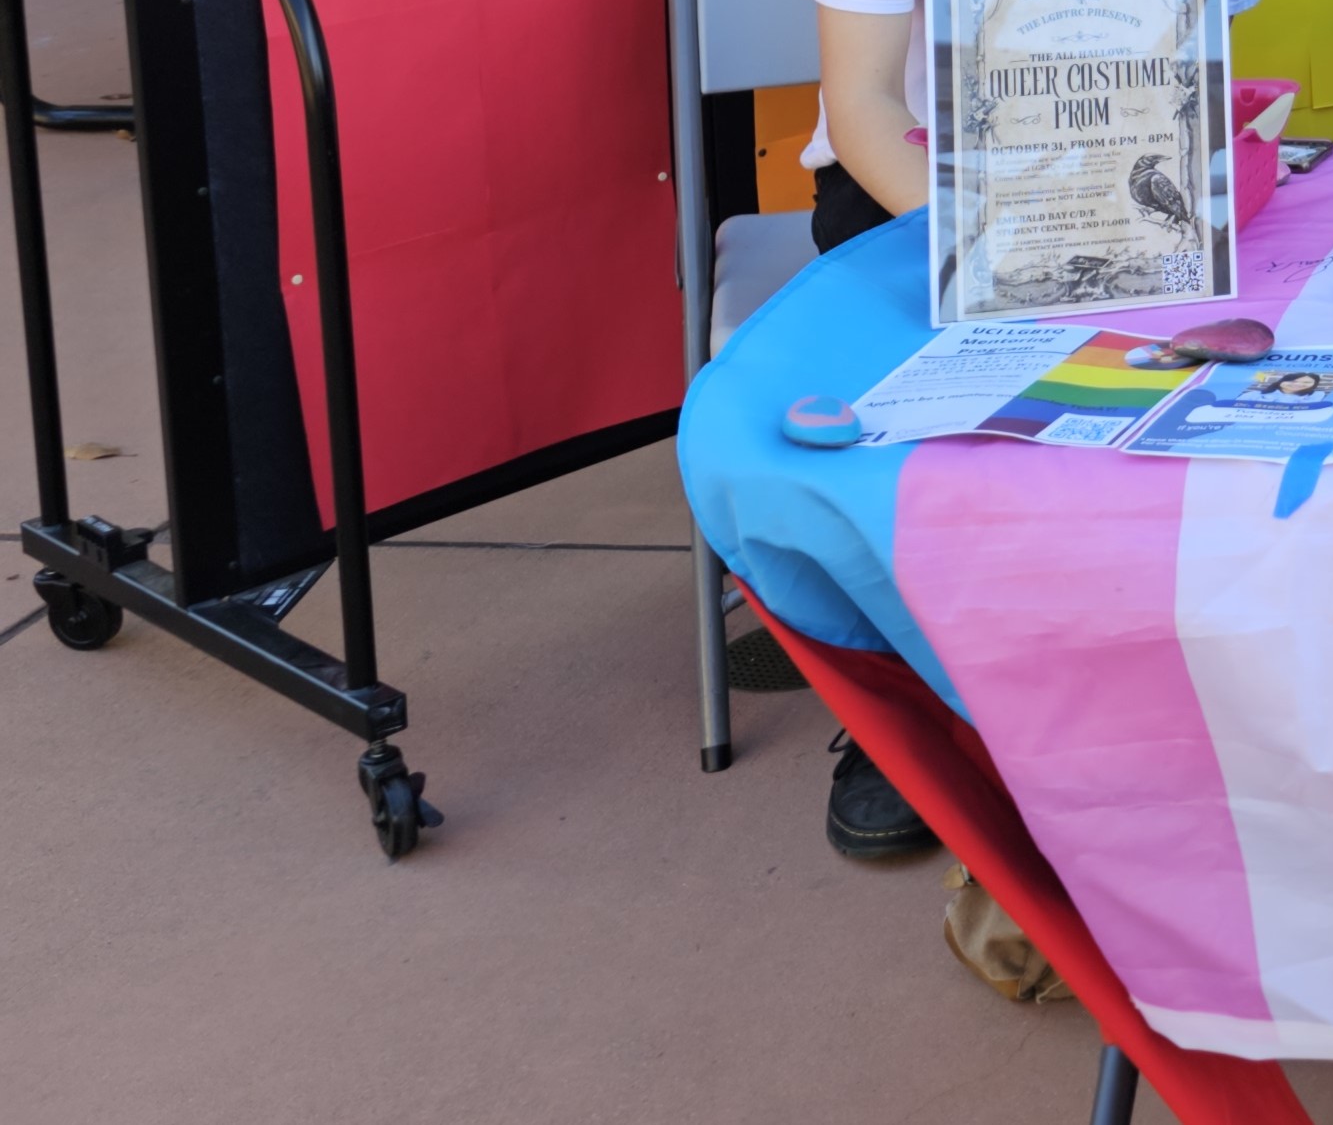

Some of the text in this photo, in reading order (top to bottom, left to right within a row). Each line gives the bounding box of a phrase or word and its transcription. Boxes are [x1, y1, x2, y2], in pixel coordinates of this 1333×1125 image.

[1017, 8, 1142, 36] THE LGBTRC PRESENTS
[1029, 48, 1133, 62] THE ALL HALLOWS
[989, 57, 1171, 101] QUEER COSTUME
[1054, 97, 1110, 132] PROM
[992, 143, 1048, 156] OCTOBER
[1071, 138, 1104, 150] FROM
[1110, 137, 1116, 147] 6
[1120, 136, 1137, 146] PM
[1148, 133, 1173, 144] 8PM
